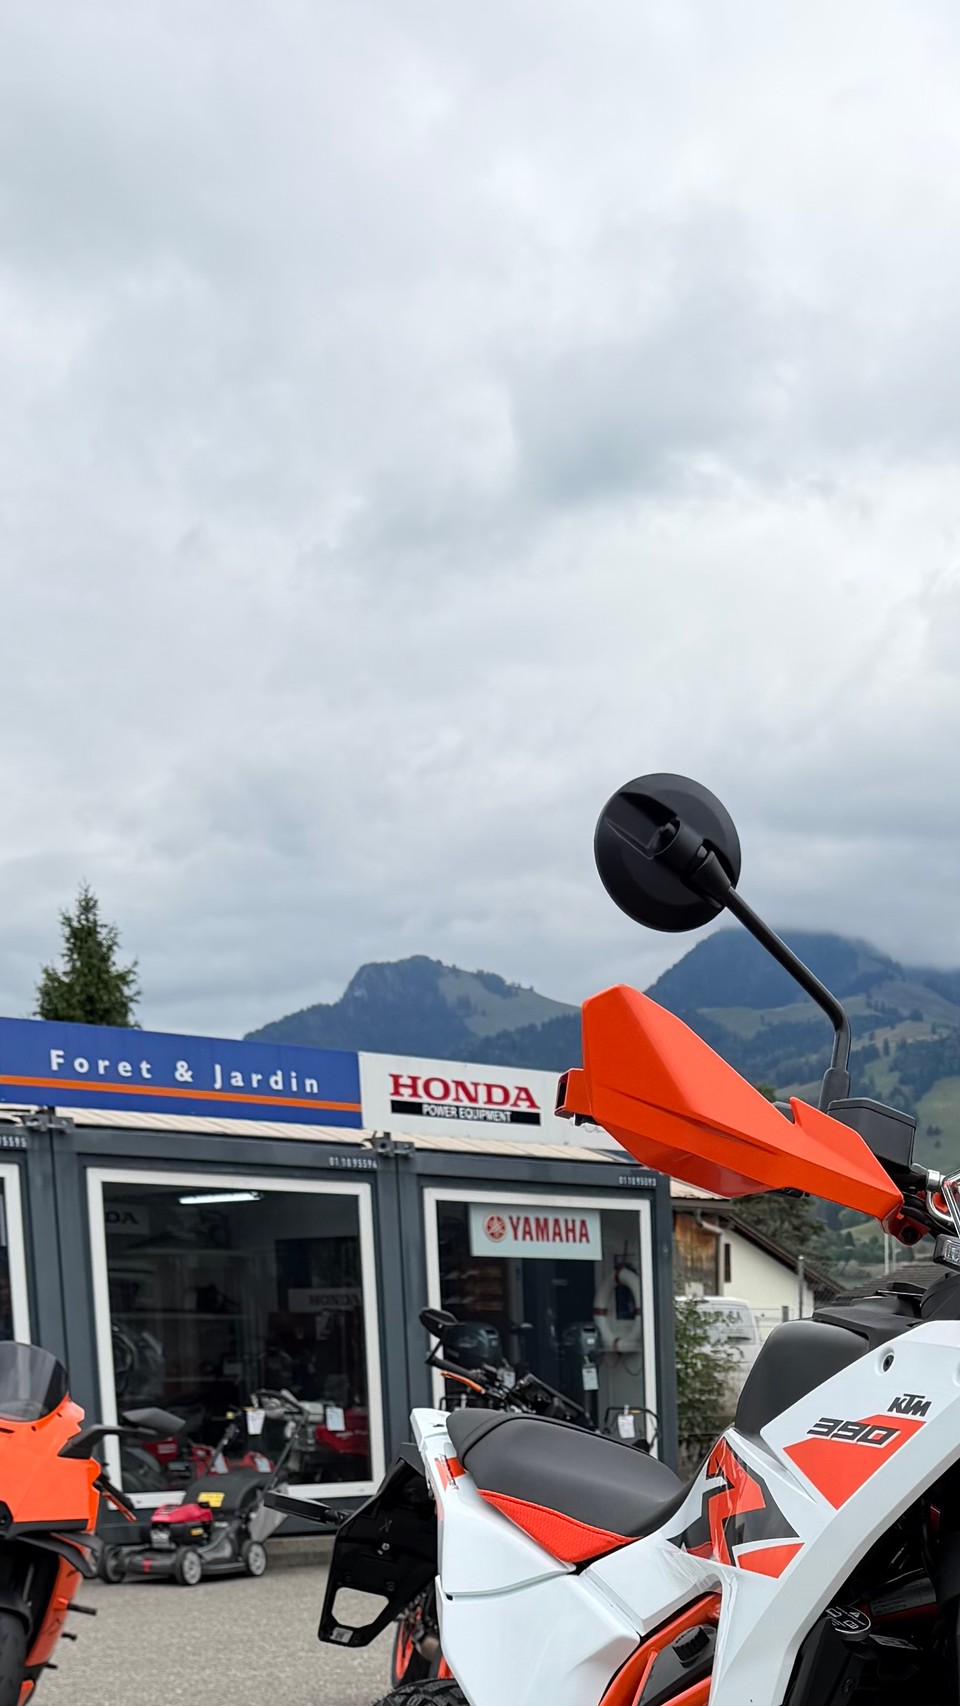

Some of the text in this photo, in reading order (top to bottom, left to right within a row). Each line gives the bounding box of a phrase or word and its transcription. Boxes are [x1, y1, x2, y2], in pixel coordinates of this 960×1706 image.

[50, 1049, 319, 1094] Foret & Jardin
[389, 1073, 541, 1110] HONDA
[421, 1103, 513, 1123] POWER EQUIPMENT
[509, 1215, 590, 1243] YAMAHA
[886, 1393, 933, 1418] KTM
[806, 1417, 901, 1447] 390
